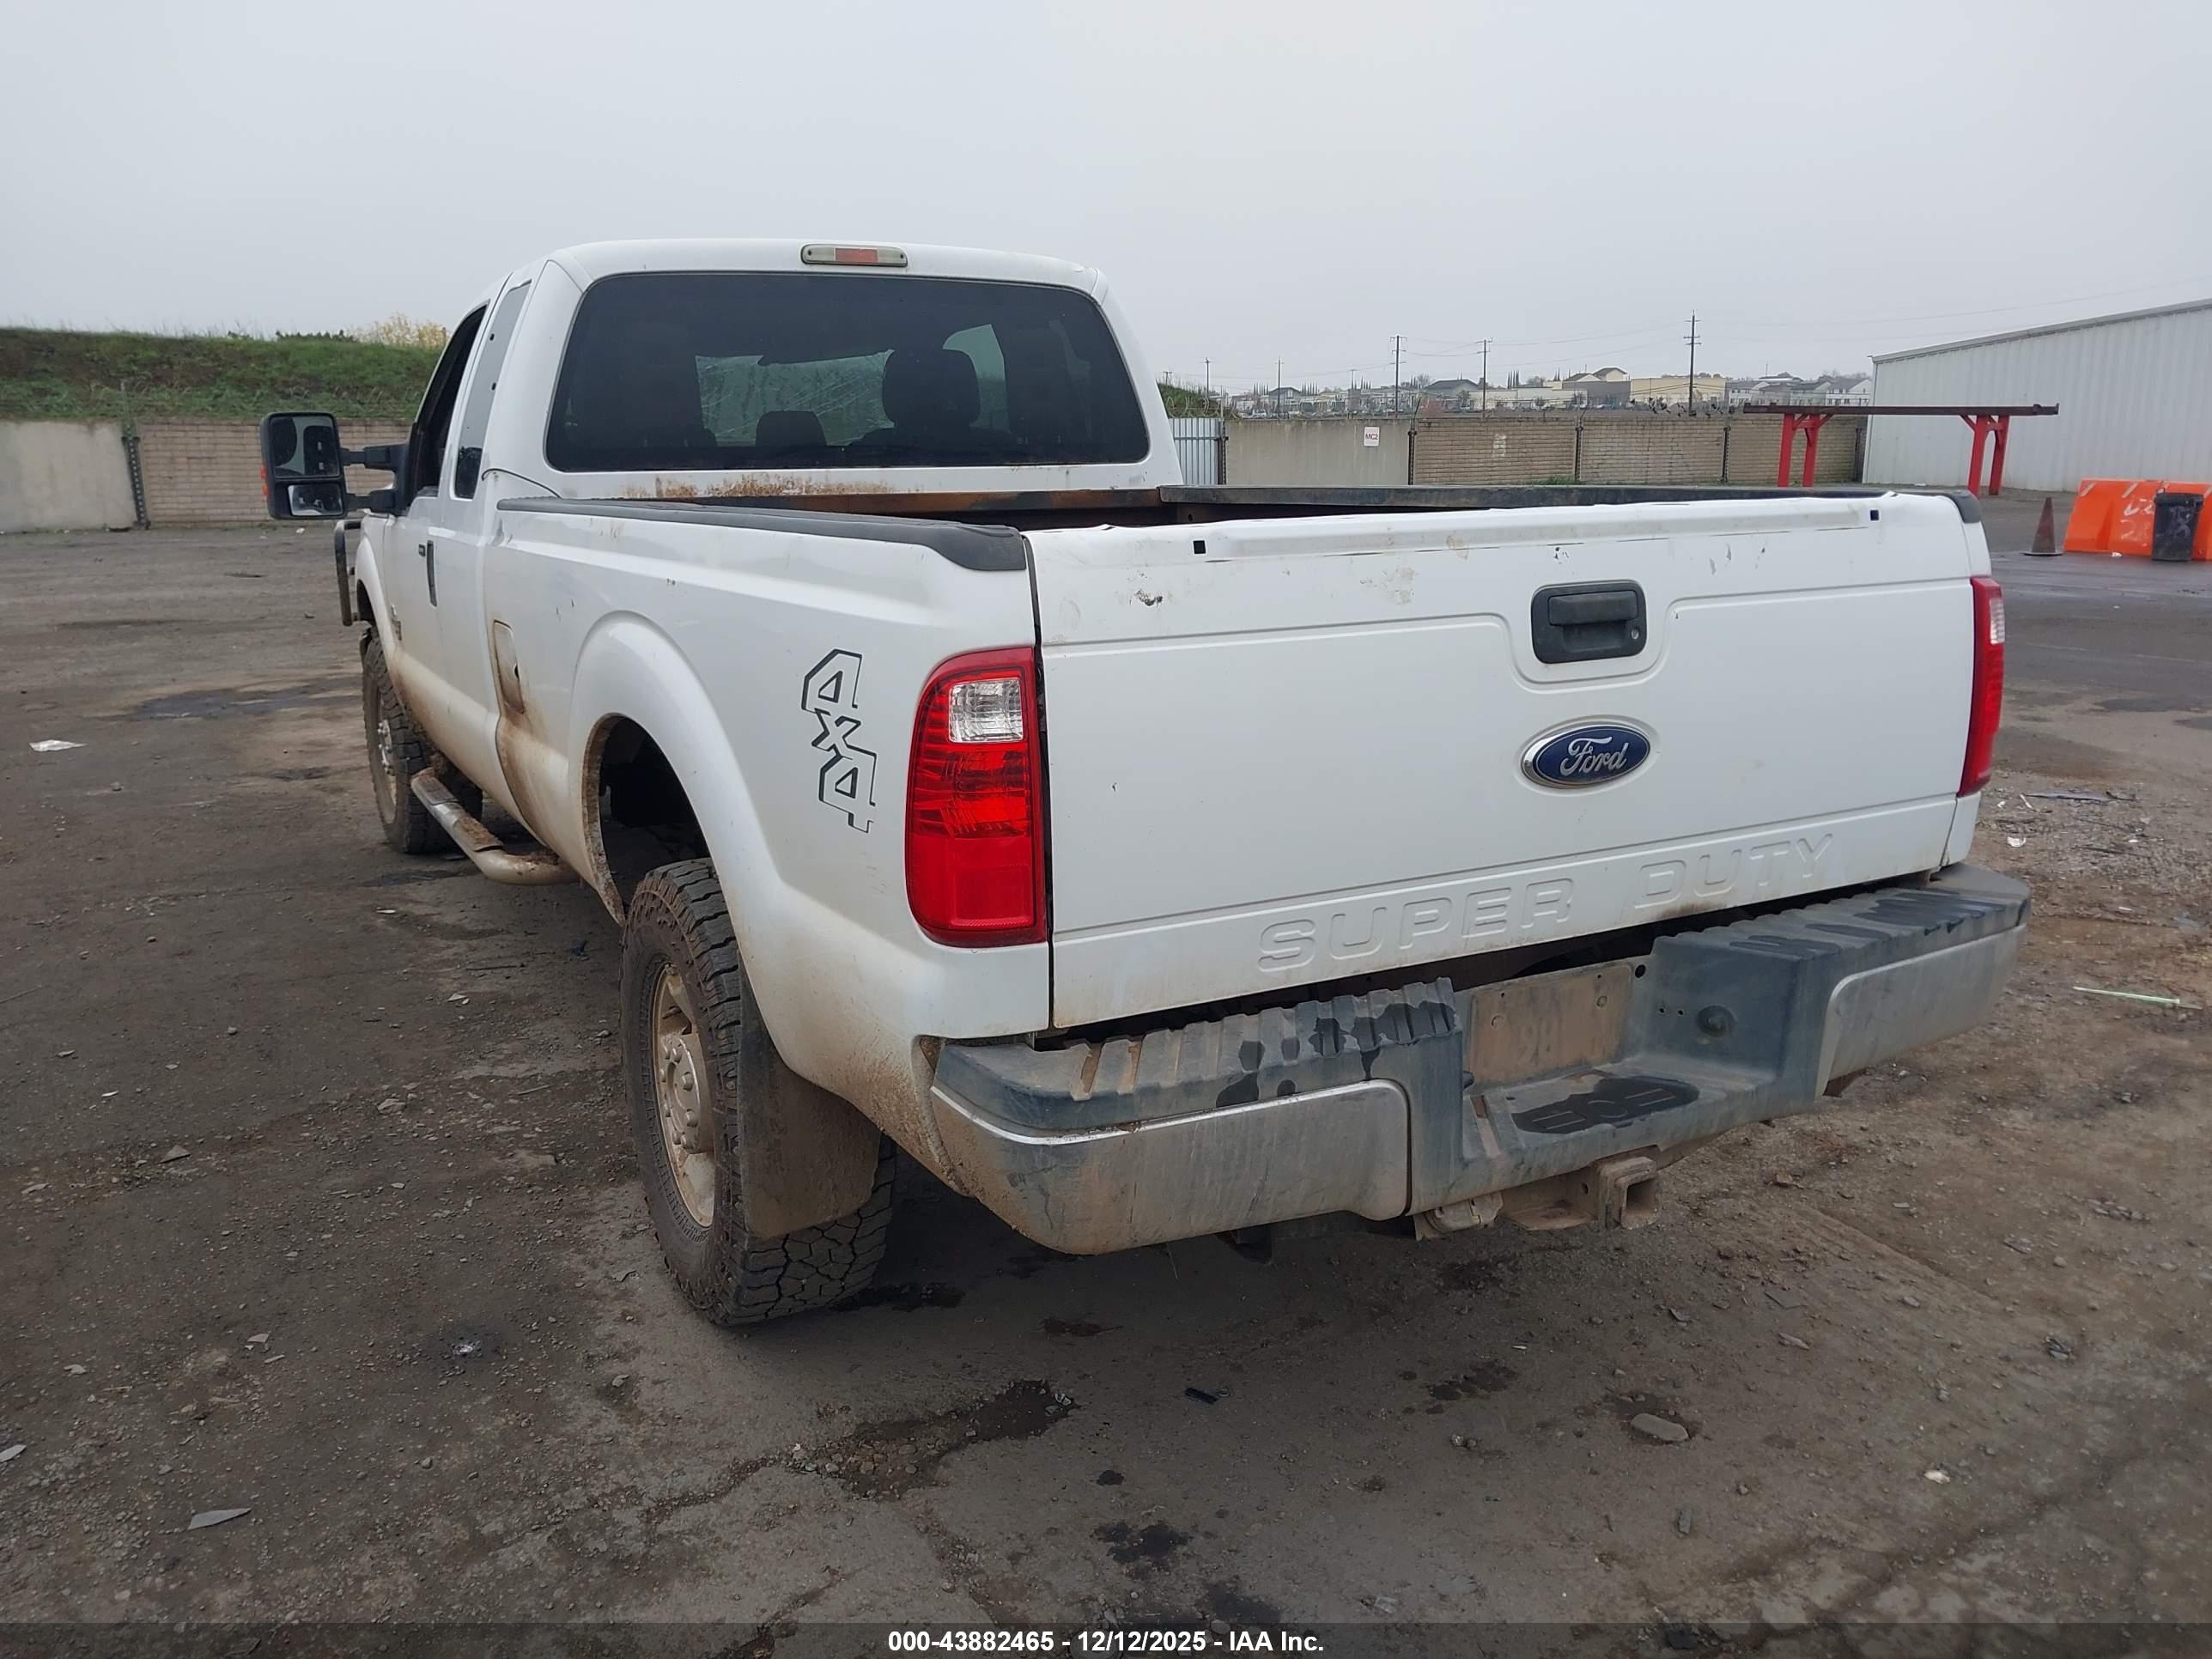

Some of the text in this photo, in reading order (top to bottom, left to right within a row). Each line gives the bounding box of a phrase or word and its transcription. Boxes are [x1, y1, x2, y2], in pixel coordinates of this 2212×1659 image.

[1559, 736, 1629, 776] Ford
[1256, 831, 1834, 974] SUPER DUTY
